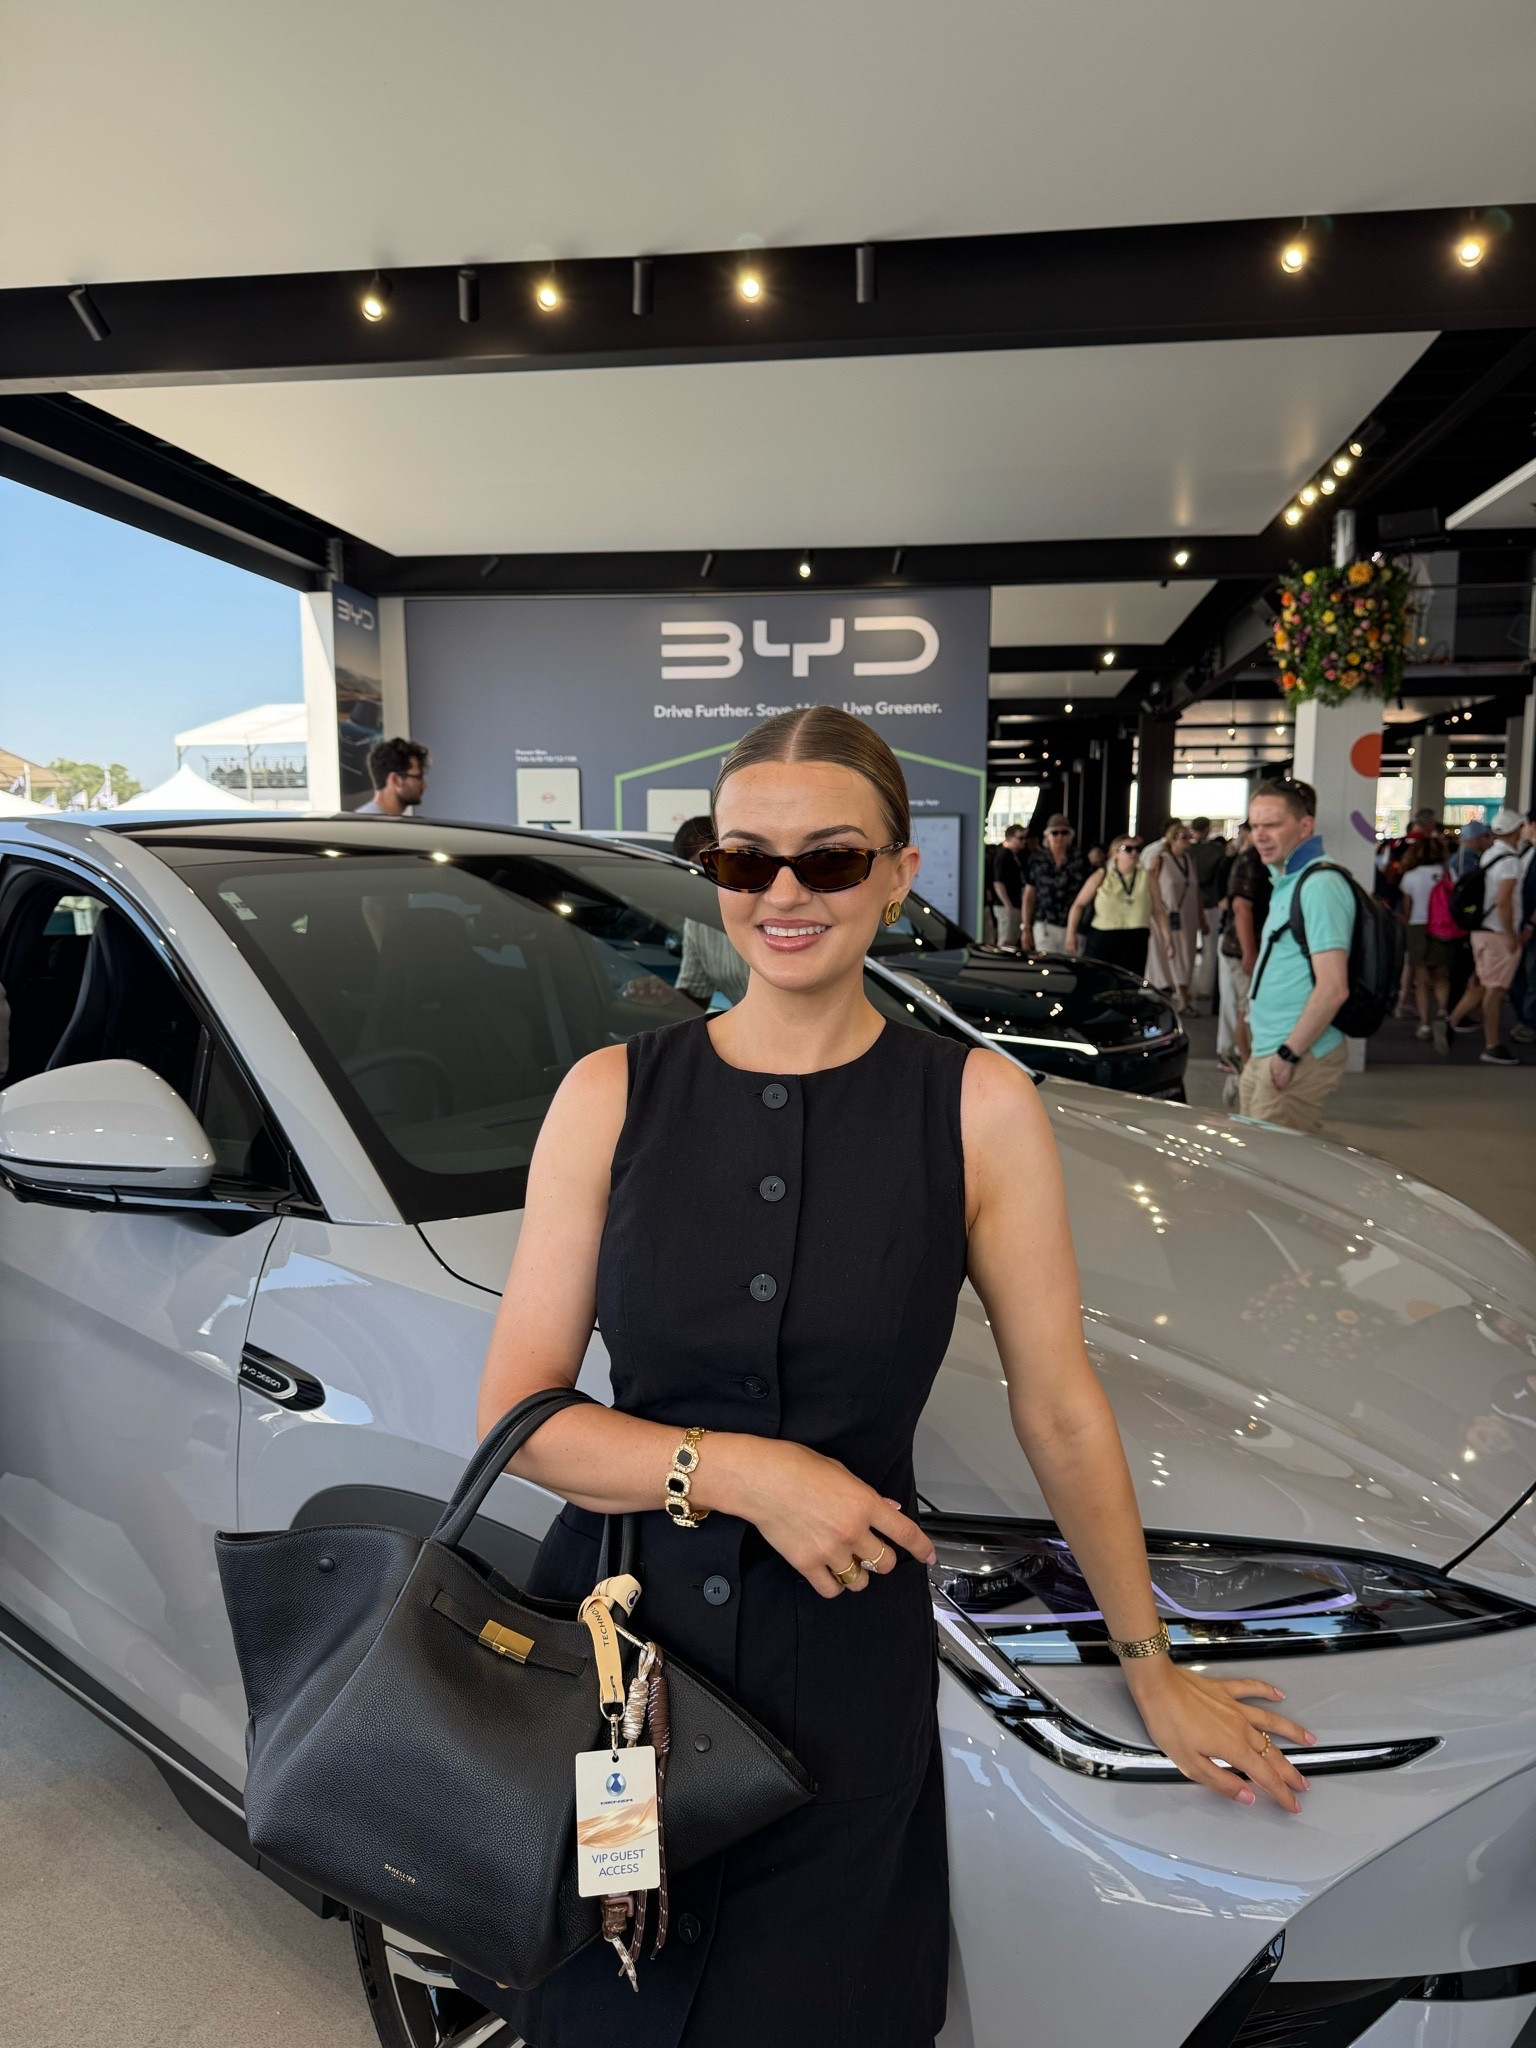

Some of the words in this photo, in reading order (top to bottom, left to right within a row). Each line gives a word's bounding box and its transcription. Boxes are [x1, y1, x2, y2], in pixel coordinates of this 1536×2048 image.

[336, 598, 375, 630] BYD
[661, 616, 940, 679] BYD
[653, 704, 693, 718] Drive
[695, 703, 754, 718] Further.
[842, 702, 874, 716] Live
[875, 701, 942, 715] Greener.
[590, 1604, 610, 1648] TECHNOL
[592, 1853, 609, 1864] VIP
[610, 1849, 646, 1862] GUEST
[599, 1863, 640, 1877] ACCESS
